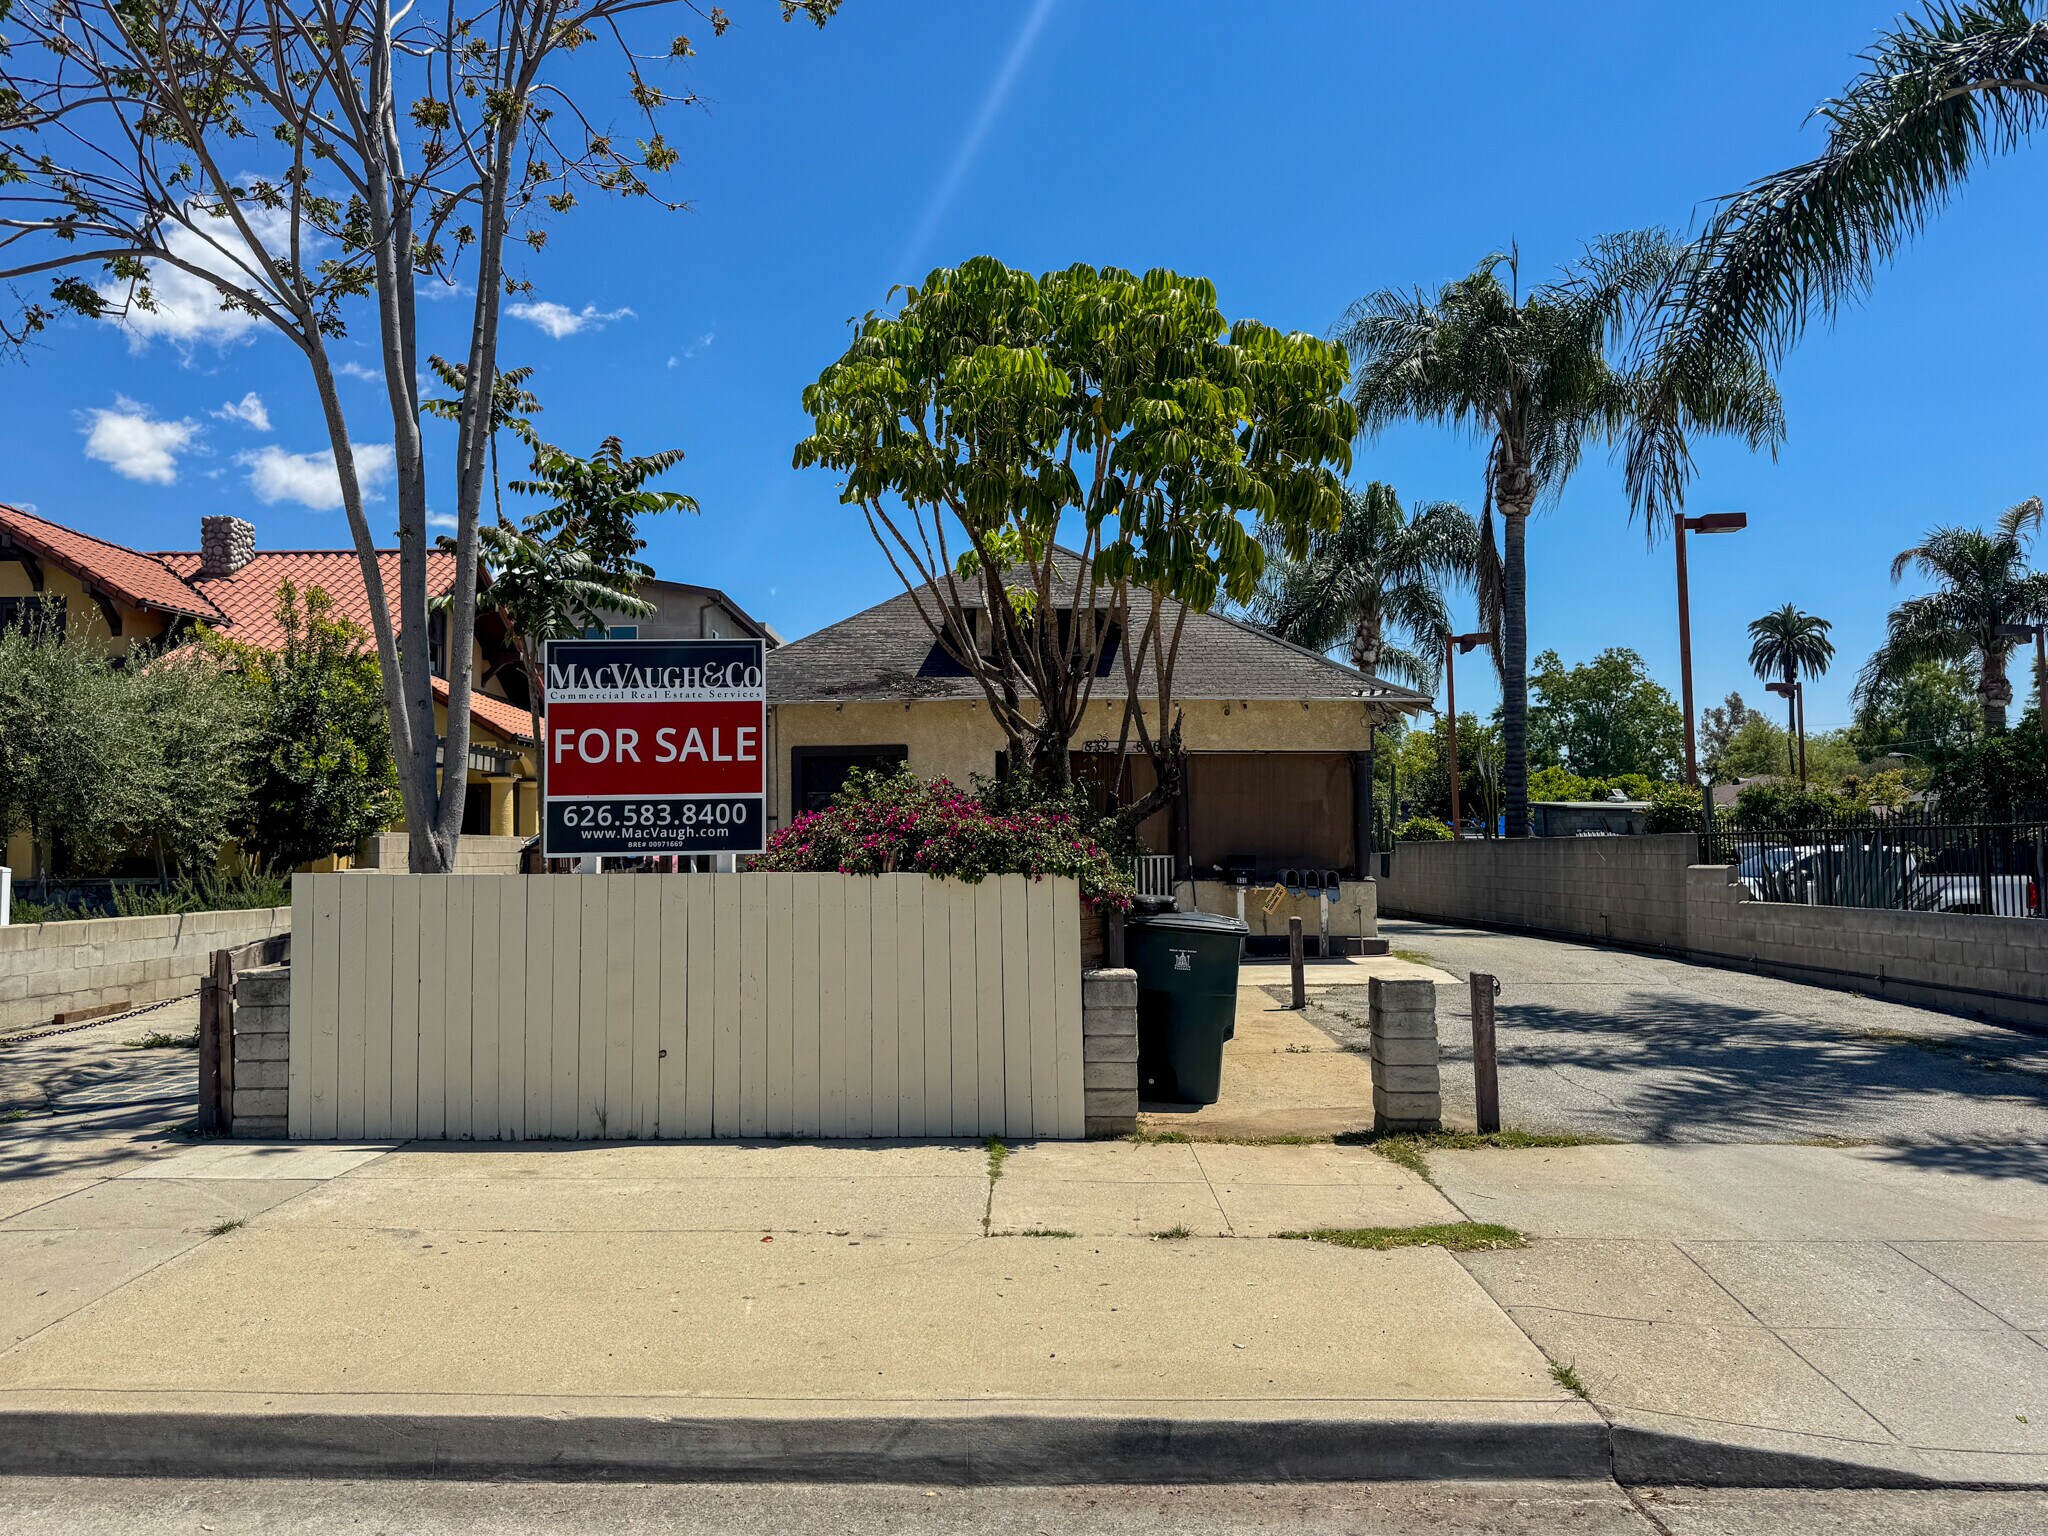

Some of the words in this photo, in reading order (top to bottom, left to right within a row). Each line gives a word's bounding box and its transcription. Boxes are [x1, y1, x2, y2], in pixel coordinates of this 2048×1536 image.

[550, 691, 624, 700] Commercial
[631, 690, 658, 699] Real
[664, 690, 703, 699] Estate
[709, 689, 760, 698] Services
[554, 728, 641, 764] FOR
[655, 726, 757, 763] SALE
[563, 803, 747, 827] 626.583.8400
[581, 827, 729, 840] www.MacVaugh.com
[648, 840, 683, 848] 00971669
